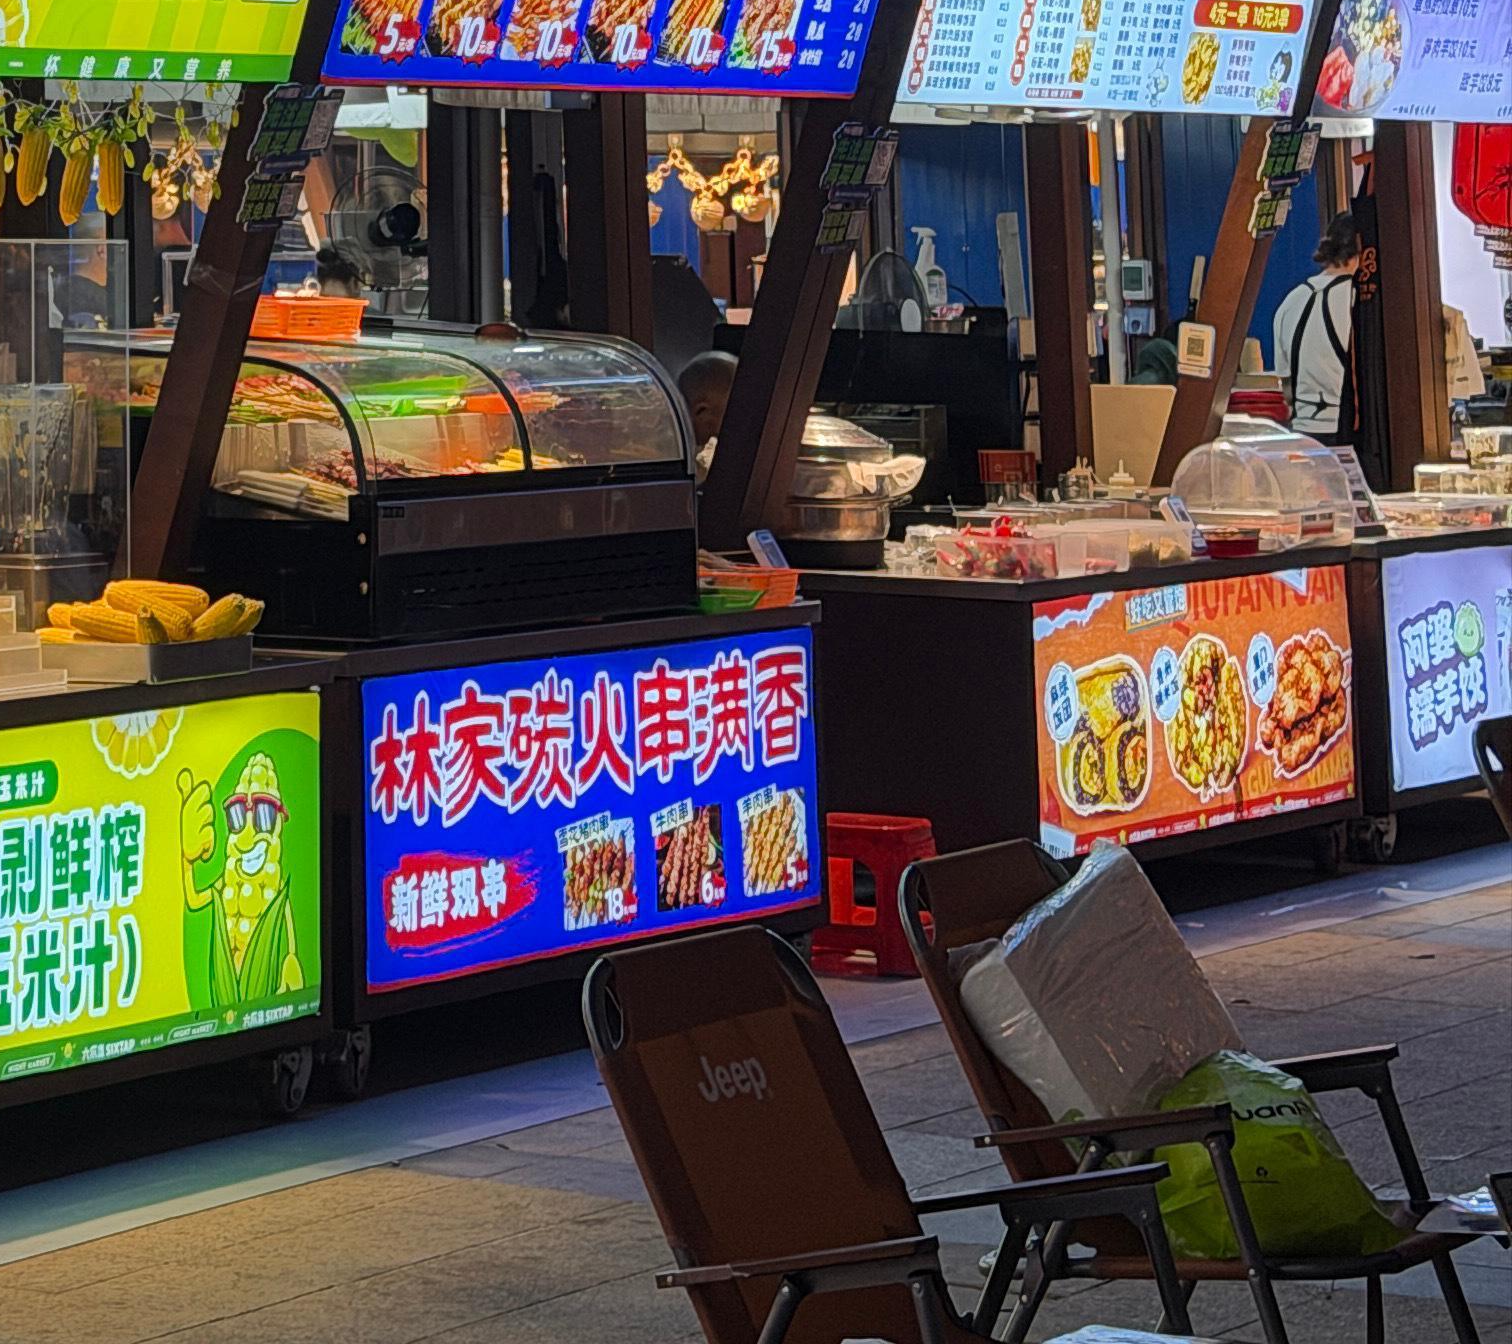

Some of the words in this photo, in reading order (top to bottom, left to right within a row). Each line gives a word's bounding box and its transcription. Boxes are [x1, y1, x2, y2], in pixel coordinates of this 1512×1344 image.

[741, 788, 774, 815] 羊肉串
[654, 803, 689, 829] 牛肉串
[698, 1055, 767, 1103] Jeep
